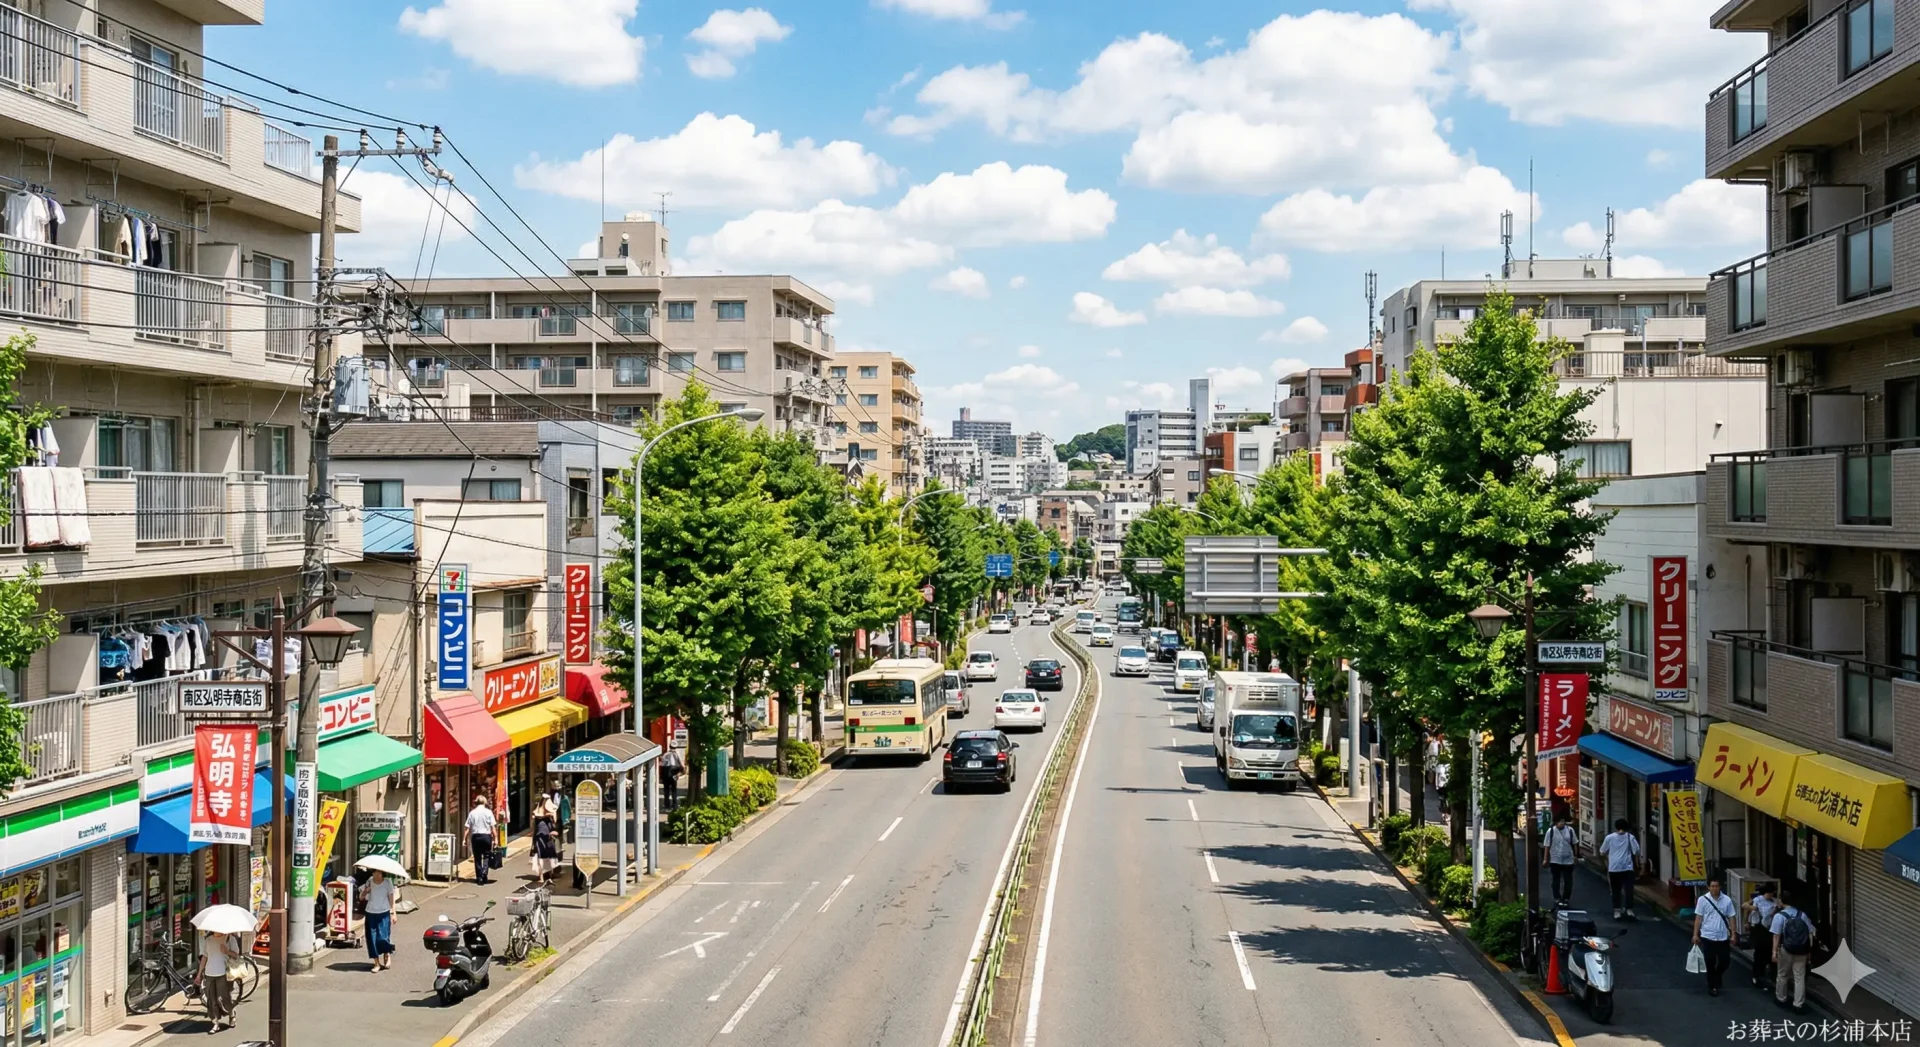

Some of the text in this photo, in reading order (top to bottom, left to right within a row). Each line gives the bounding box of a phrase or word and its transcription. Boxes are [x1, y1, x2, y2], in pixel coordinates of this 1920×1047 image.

[570, 568, 587, 659] クリーニング
[1658, 560, 1683, 684] クリーニング
[443, 599, 464, 683] コンビニ
[184, 689, 262, 706] 南区弘明寺商店街
[486, 665, 537, 708] クリーニング
[1656, 690, 1686, 699] コンビニ
[324, 696, 371, 730] コンビニ
[1554, 680, 1575, 746] ラーメン
[1614, 704, 1662, 744] クリーニング
[209, 733, 236, 817] 弘明寺
[1713, 745, 1775, 796] ラーメン
